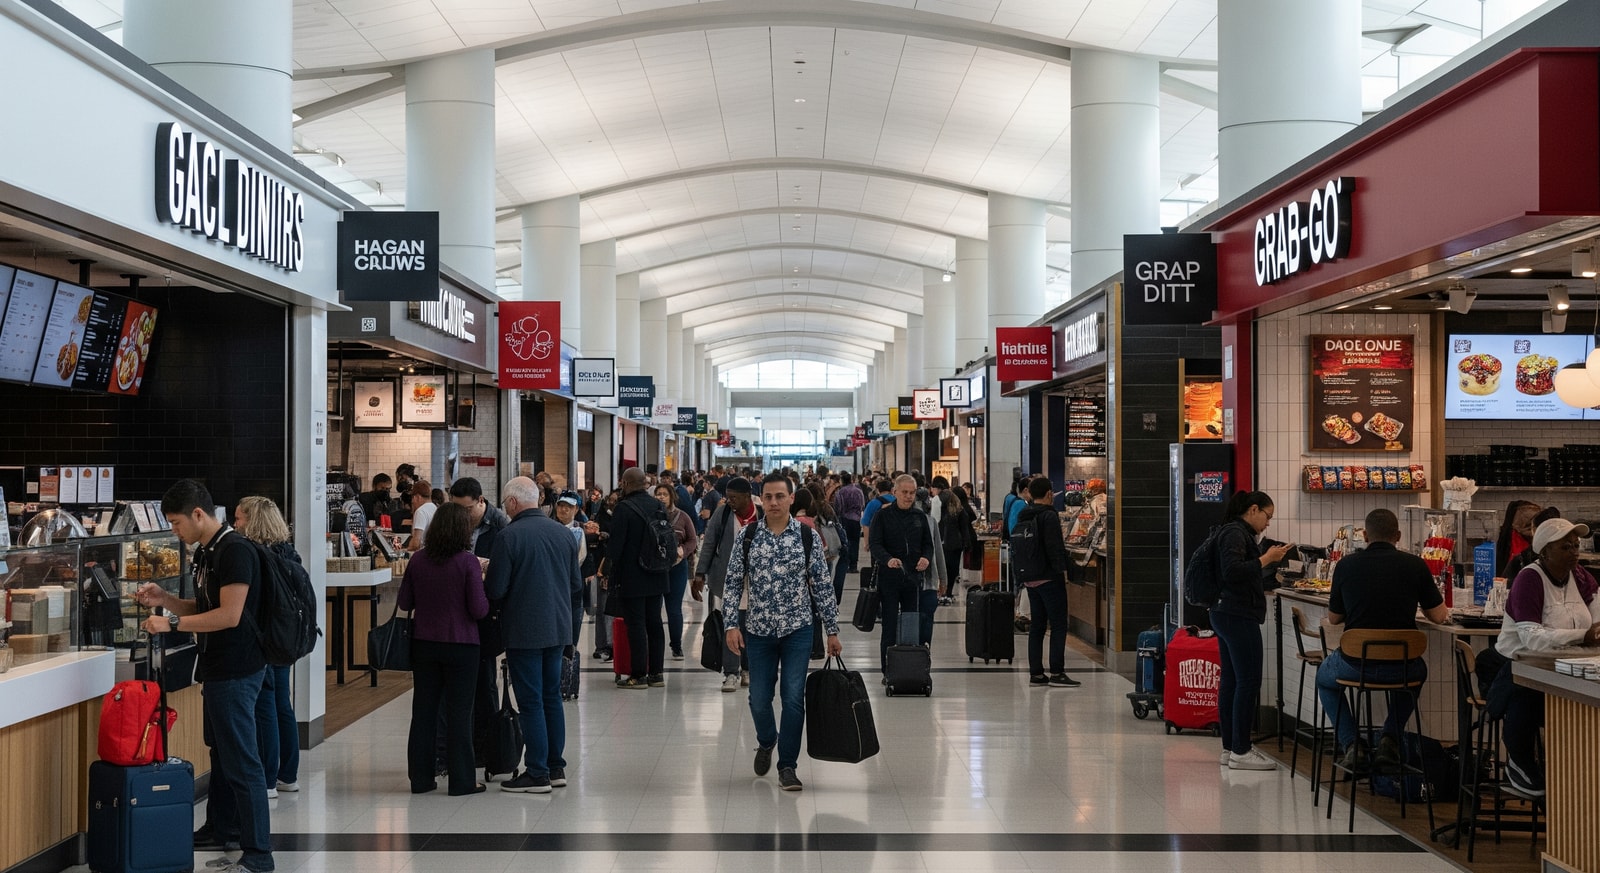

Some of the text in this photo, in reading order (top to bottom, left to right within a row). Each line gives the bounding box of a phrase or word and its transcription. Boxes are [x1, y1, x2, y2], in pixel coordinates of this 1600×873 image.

[169, 122, 230, 244] GACL
[354, 239, 425, 255] HAGAN
[1135, 260, 1201, 281] GRAP
[1144, 283, 1196, 303] DITT
